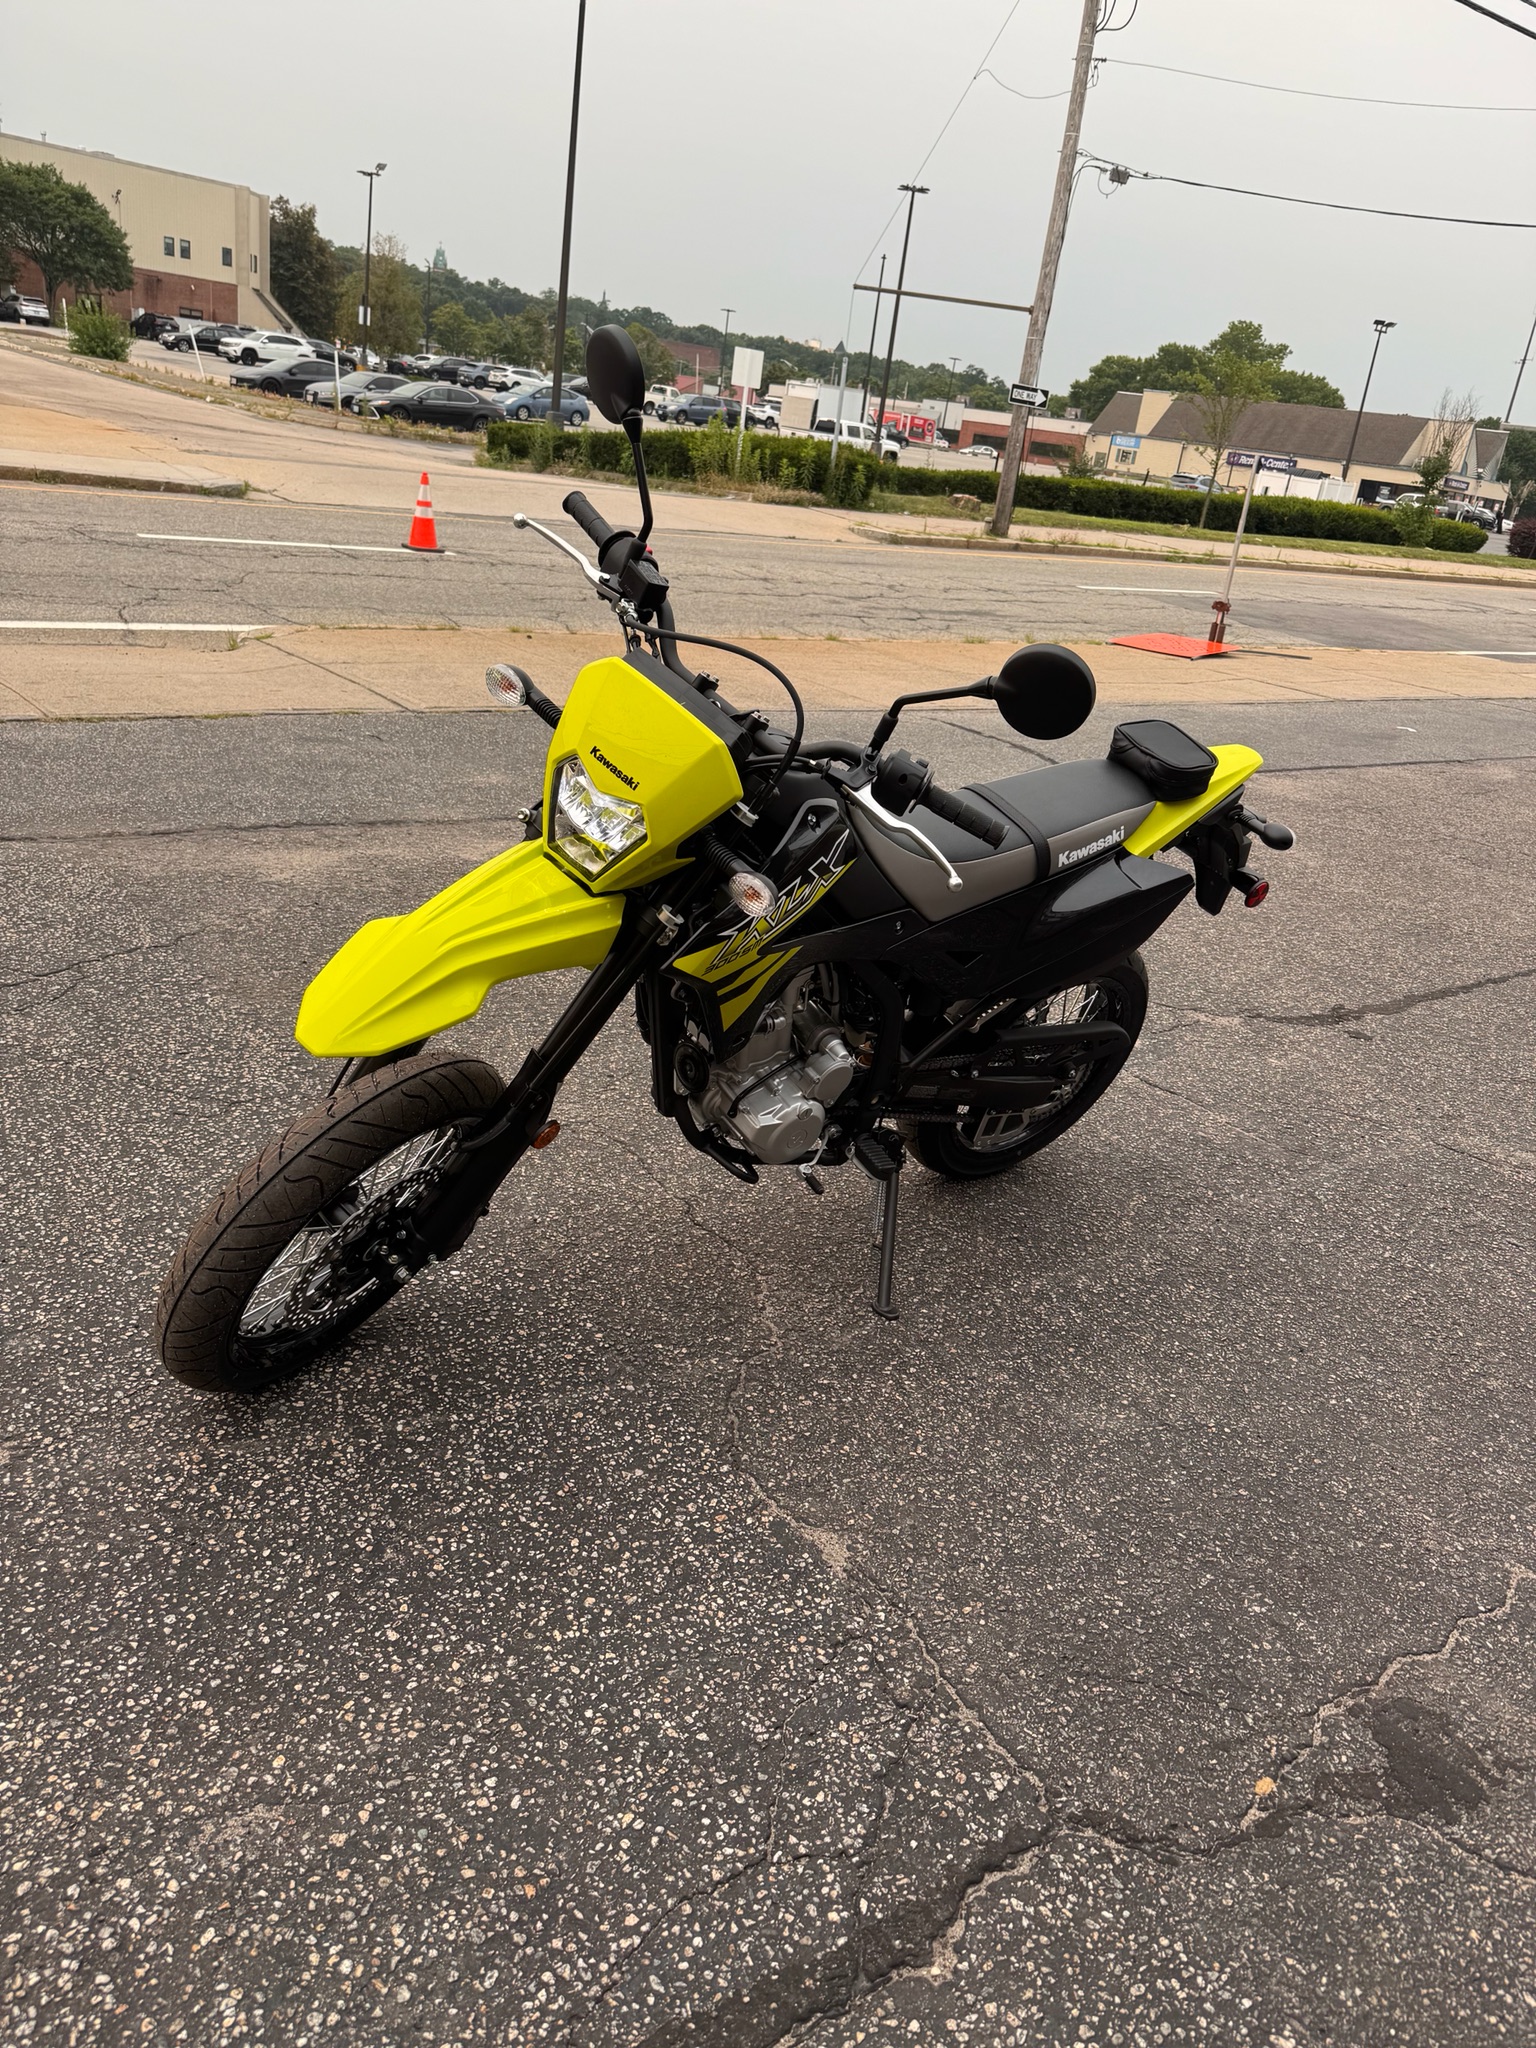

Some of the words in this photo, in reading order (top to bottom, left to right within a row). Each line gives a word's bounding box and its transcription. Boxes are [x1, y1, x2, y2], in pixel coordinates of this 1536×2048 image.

[1014, 390, 1025, 399] ONE
[1026, 392, 1037, 401] WAY
[590, 746, 640, 791] Kawasaki
[1058, 825, 1125, 868] Kawasaki
